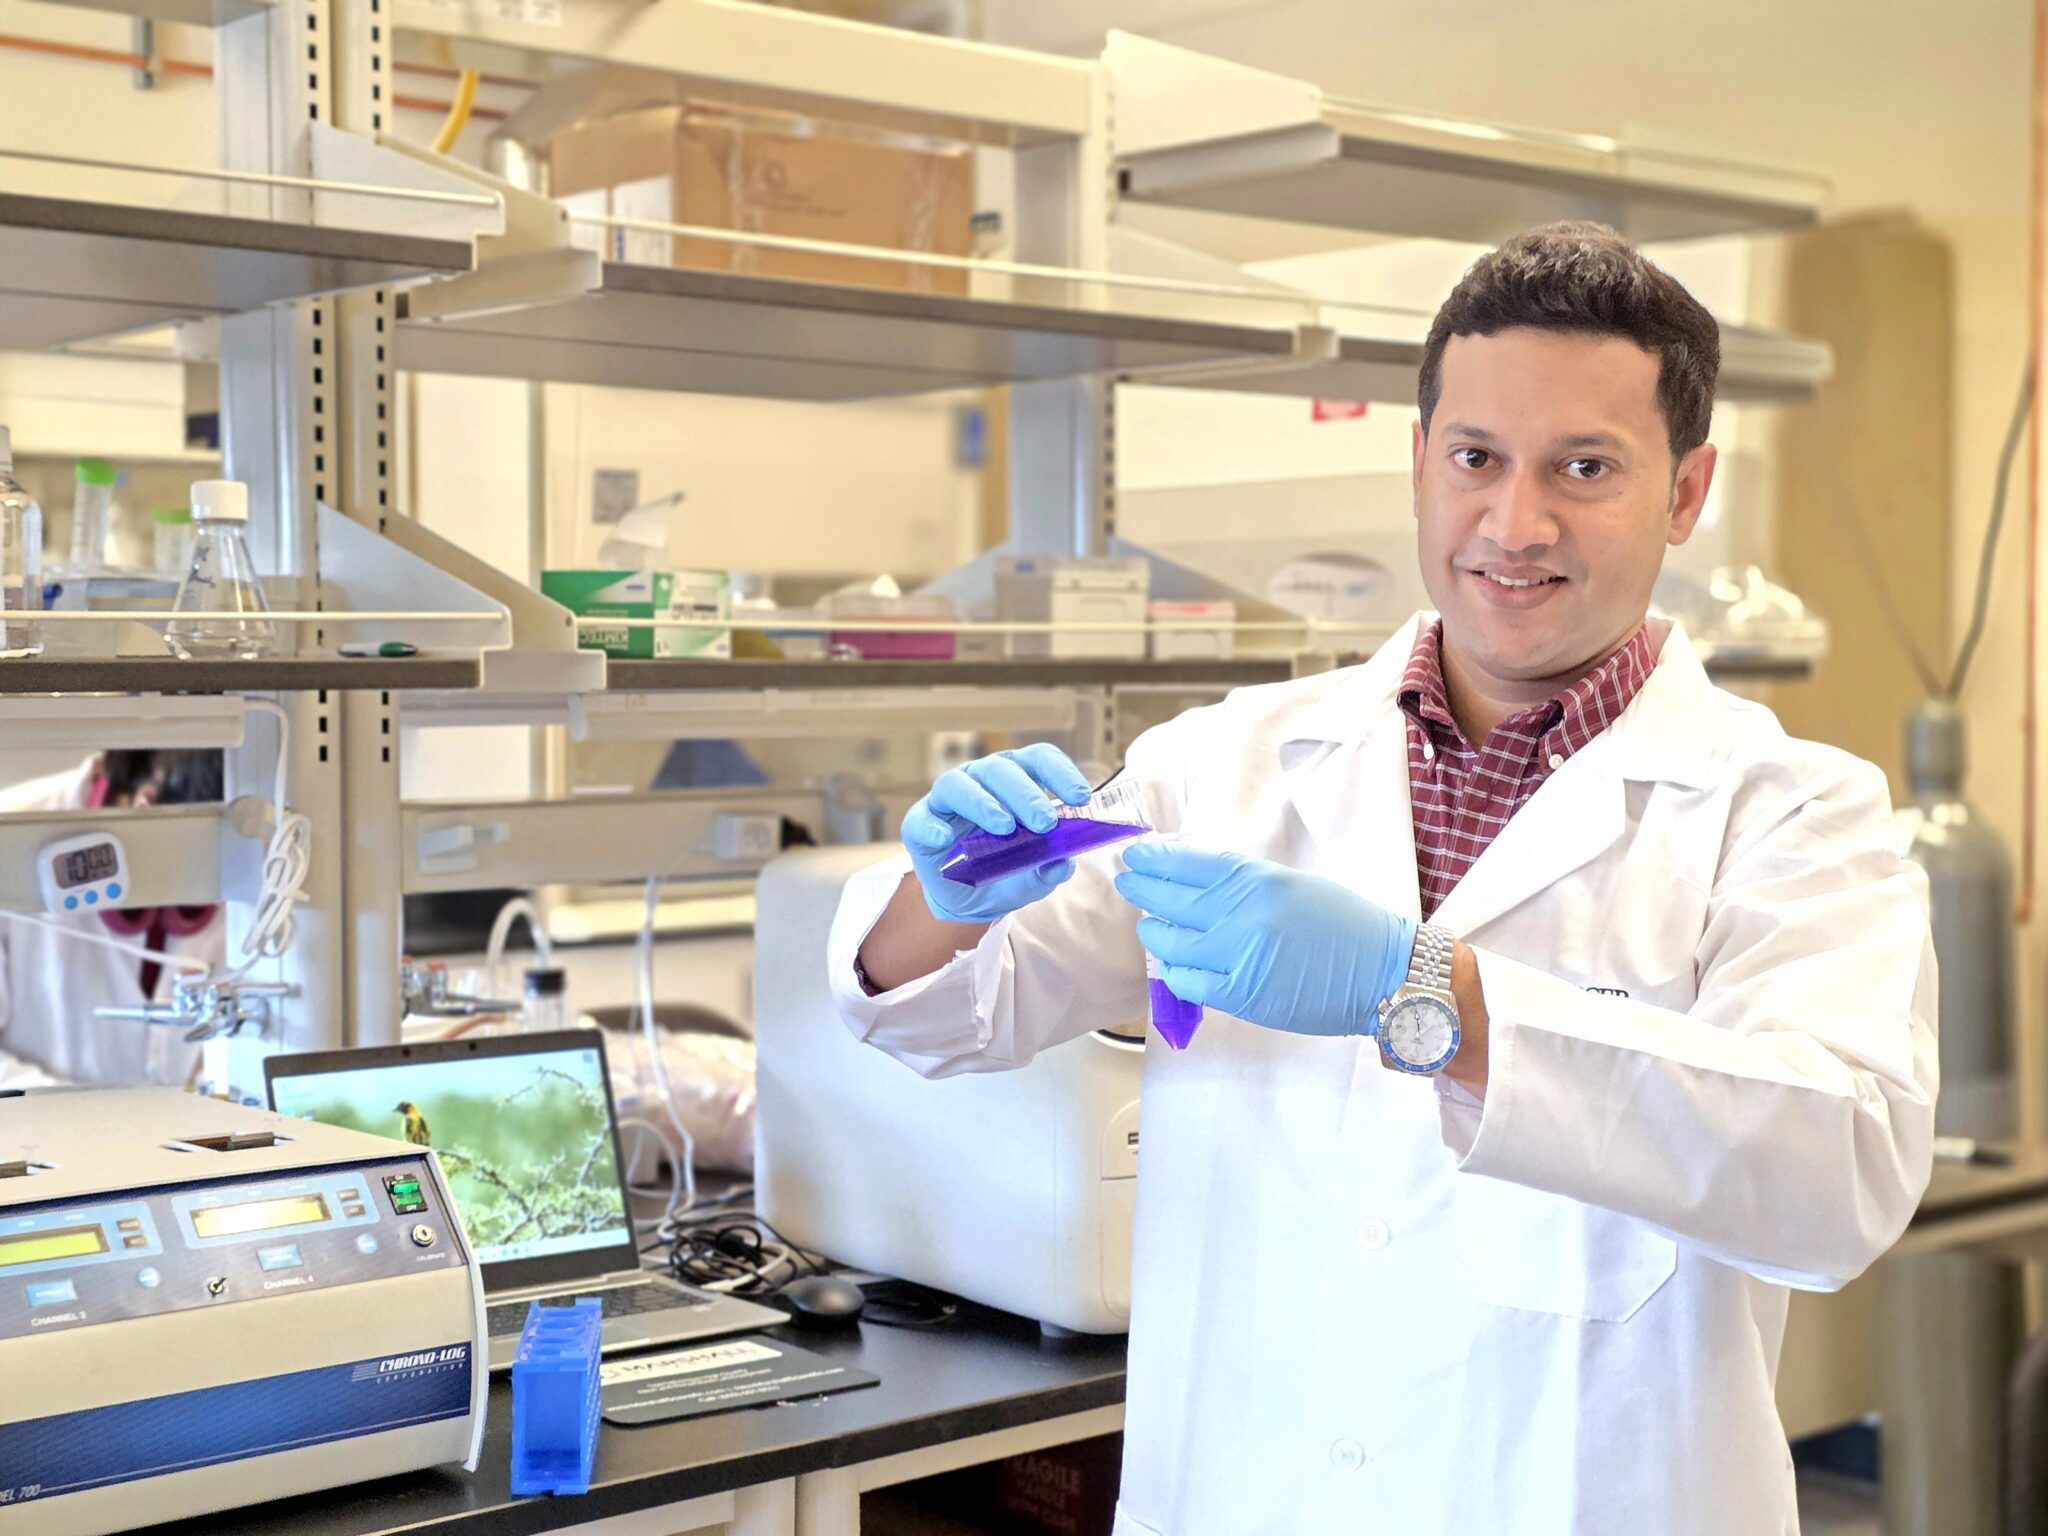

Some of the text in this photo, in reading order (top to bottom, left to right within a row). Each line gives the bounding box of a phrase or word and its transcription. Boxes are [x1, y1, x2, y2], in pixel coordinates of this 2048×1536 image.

[578, 630, 629, 644] KIMTEC
[264, 1274, 315, 1290] CHANNEL 4
[31, 1312, 78, 1327] CHANNEL
[379, 1346, 466, 1373] CHRONO-LOG
[19, 1484, 41, 1499] 700
